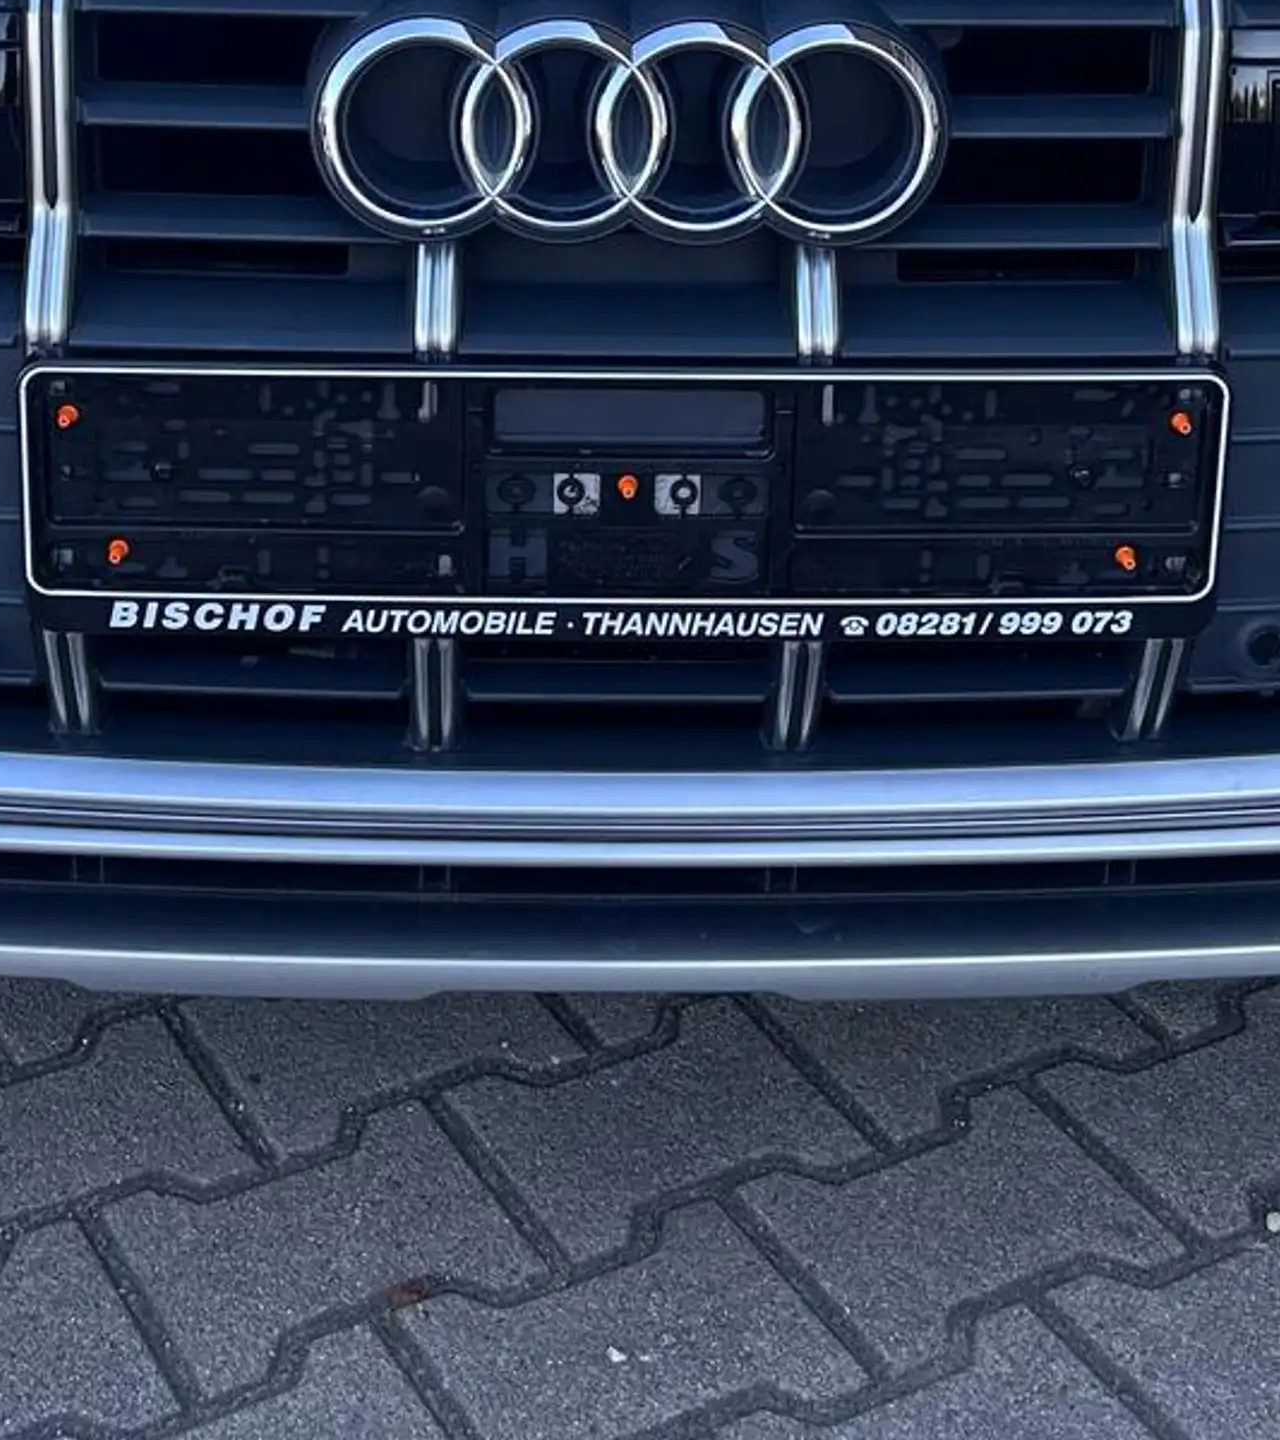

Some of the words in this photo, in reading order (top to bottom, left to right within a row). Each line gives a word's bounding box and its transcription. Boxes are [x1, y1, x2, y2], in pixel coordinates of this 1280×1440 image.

[109, 600, 327, 632] BISCHOF
[341, 609, 557, 636] AUTOMOBILE
[582, 611, 825, 637] THANNHAUSEN
[997, 611, 1064, 635] 999
[1071, 610, 1133, 634] 073
